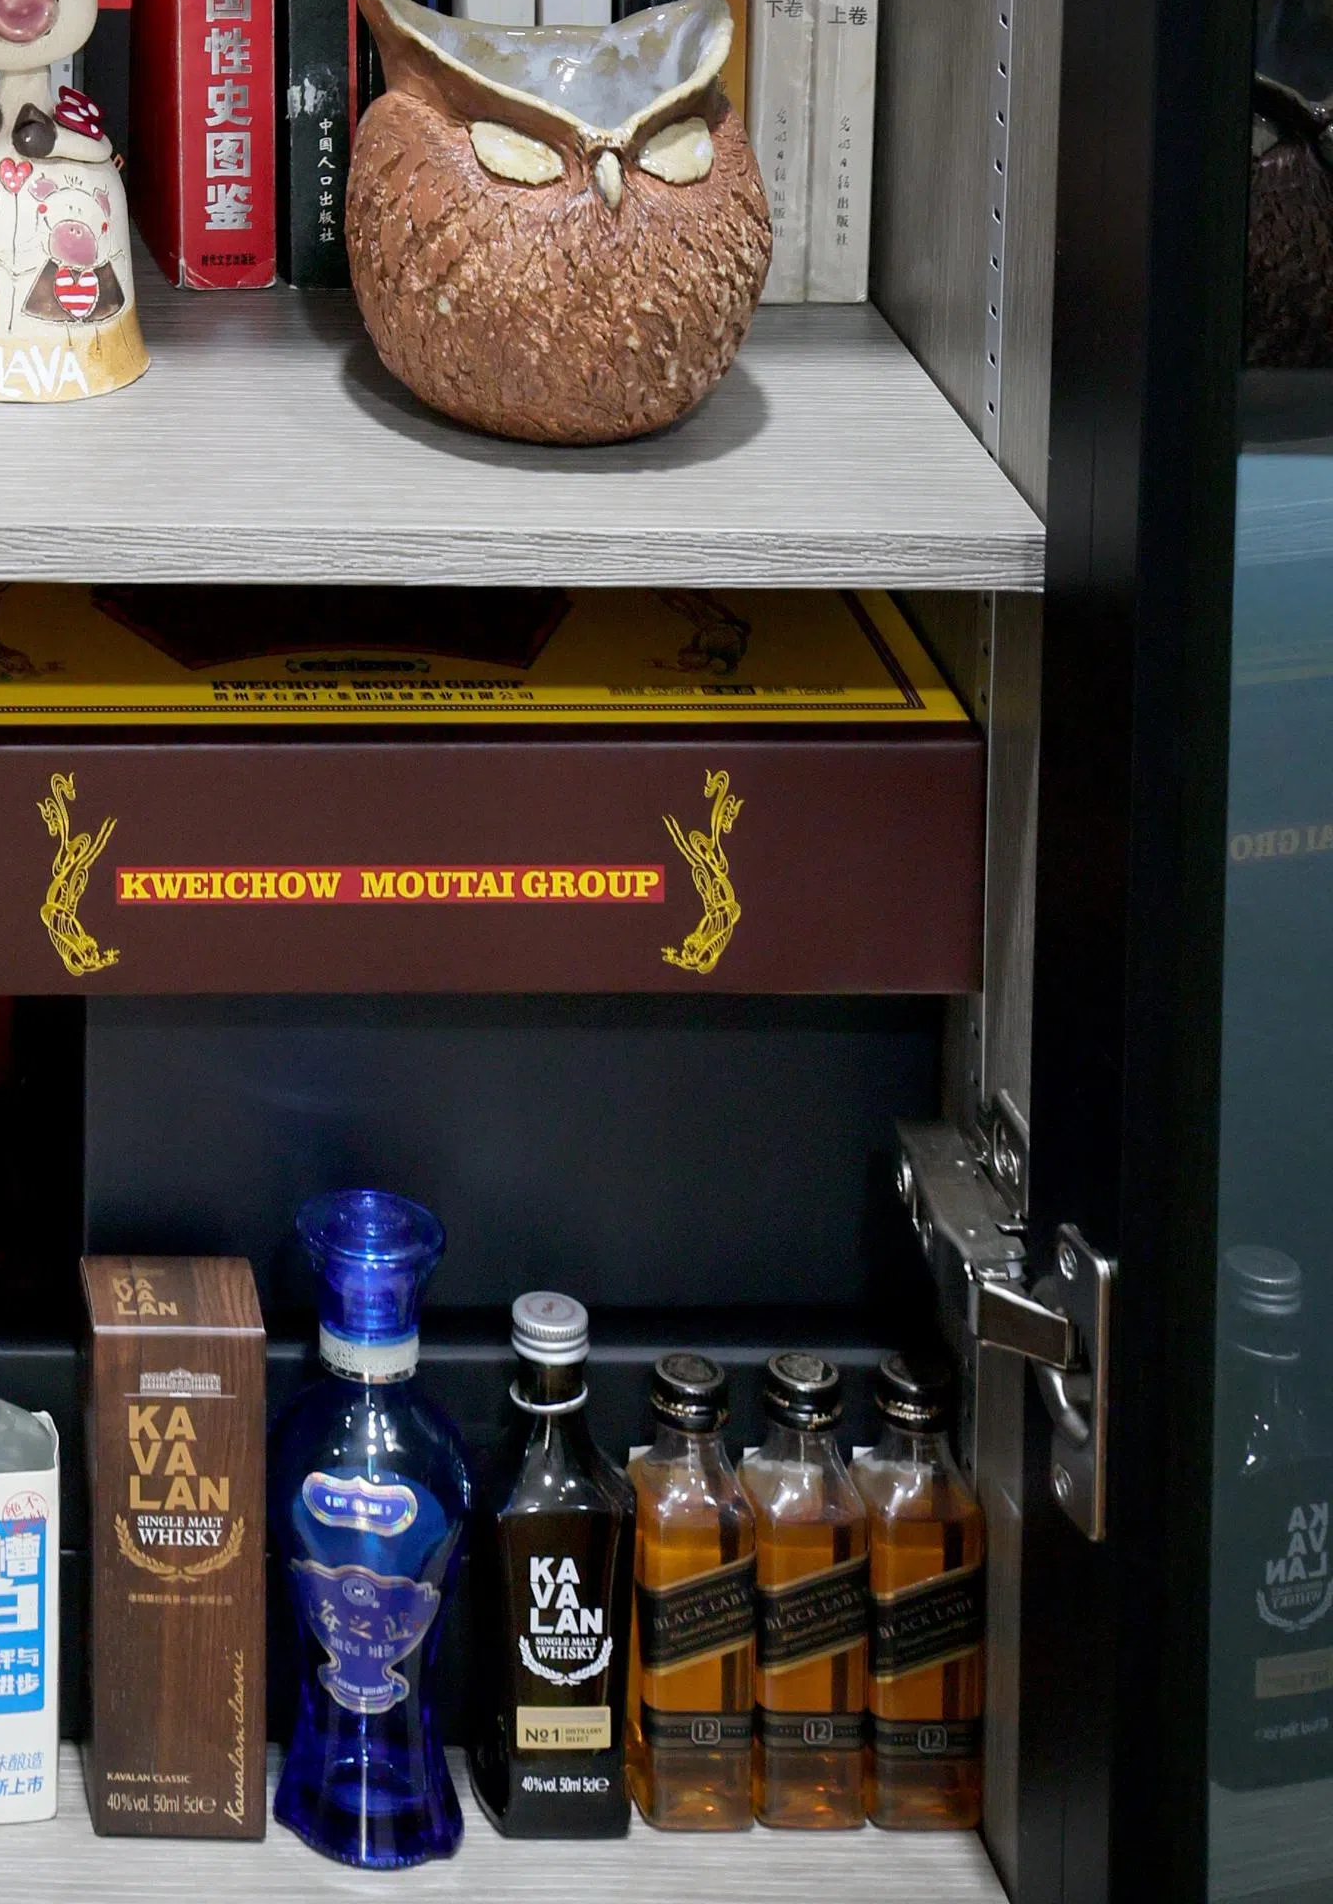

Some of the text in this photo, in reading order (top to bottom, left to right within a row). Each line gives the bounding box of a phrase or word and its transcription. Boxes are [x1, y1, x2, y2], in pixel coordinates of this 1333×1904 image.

[765, 0, 804, 19] 下卷
[827, 6, 868, 25] 上卷
[317, 118, 336, 243] 中国人口出版社
[120, 870, 661, 900] KWEICHOW MOUTAI GROUP
[113, 1277, 154, 1291] KA
[114, 1289, 156, 1302] VA
[117, 1302, 178, 1316] LAN
[128, 1404, 197, 1441] KA
[129, 1441, 197, 1476] VA
[129, 1475, 230, 1512] LAN
[137, 1515, 223, 1529] SINGLE MALT
[138, 1529, 223, 1546] WHISKY
[530, 1556, 580, 1584] KA
[530, 1583, 580, 1609] VA
[530, 1608, 603, 1634] LAN
[536, 1647, 598, 1660] WHISKY
[695, 1721, 716, 1741] 12
[807, 1721, 829, 1741] 12
[921, 1728, 942, 1749] 12
[107, 1772, 191, 1784] KAVALAN CLASSIC
[107, 1792, 151, 1811] 40%vol.
[153, 1793, 180, 1813] 50ml
